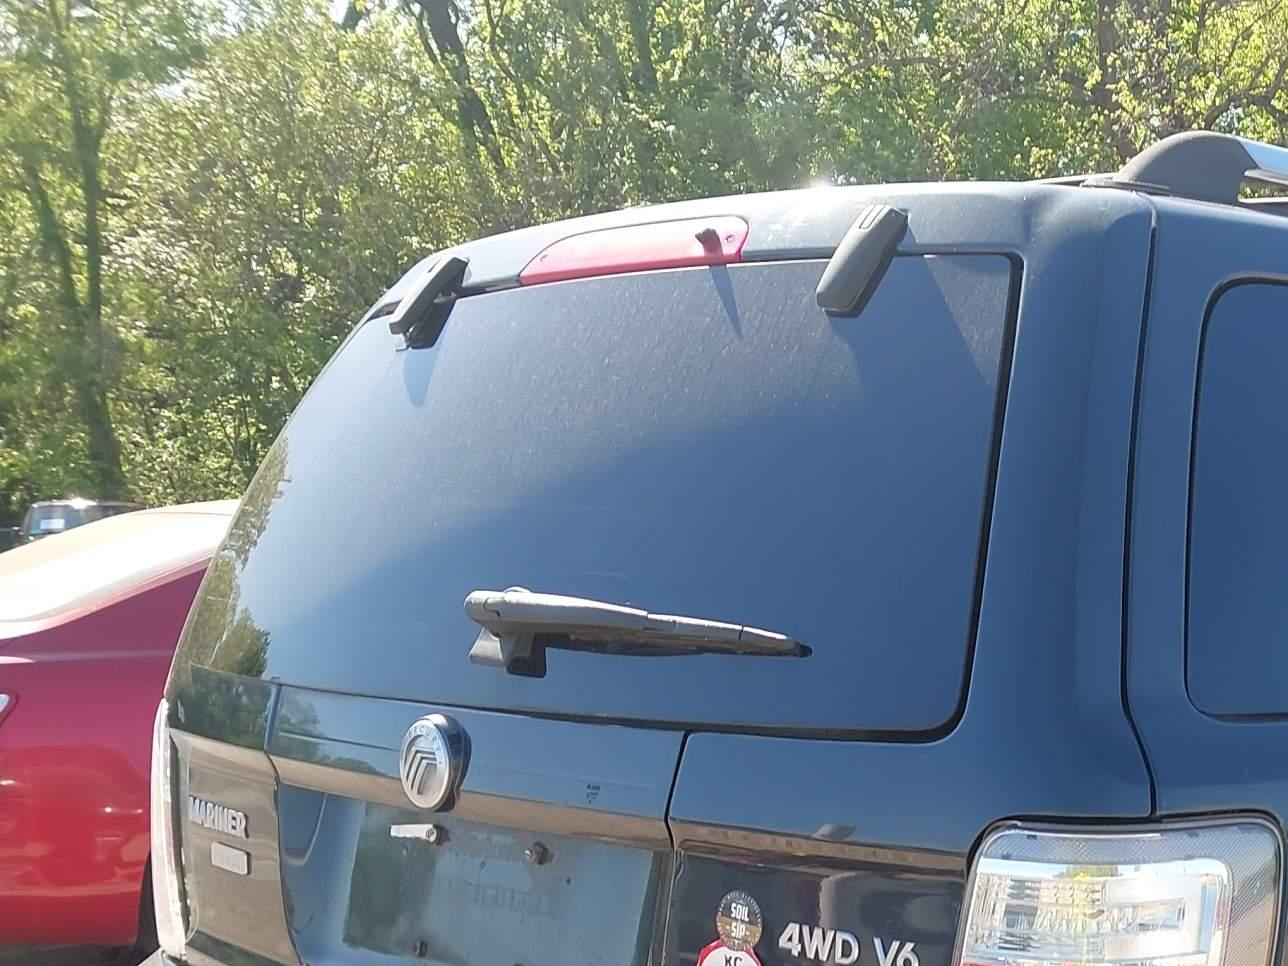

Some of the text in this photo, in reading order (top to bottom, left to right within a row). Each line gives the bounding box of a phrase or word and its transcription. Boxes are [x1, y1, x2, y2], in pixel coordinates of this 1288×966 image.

[404, 725, 442, 752] ERCURY
[188, 796, 249, 838] MARINER
[731, 903, 749, 922] SOIL
[778, 922, 859, 964] 4WD
